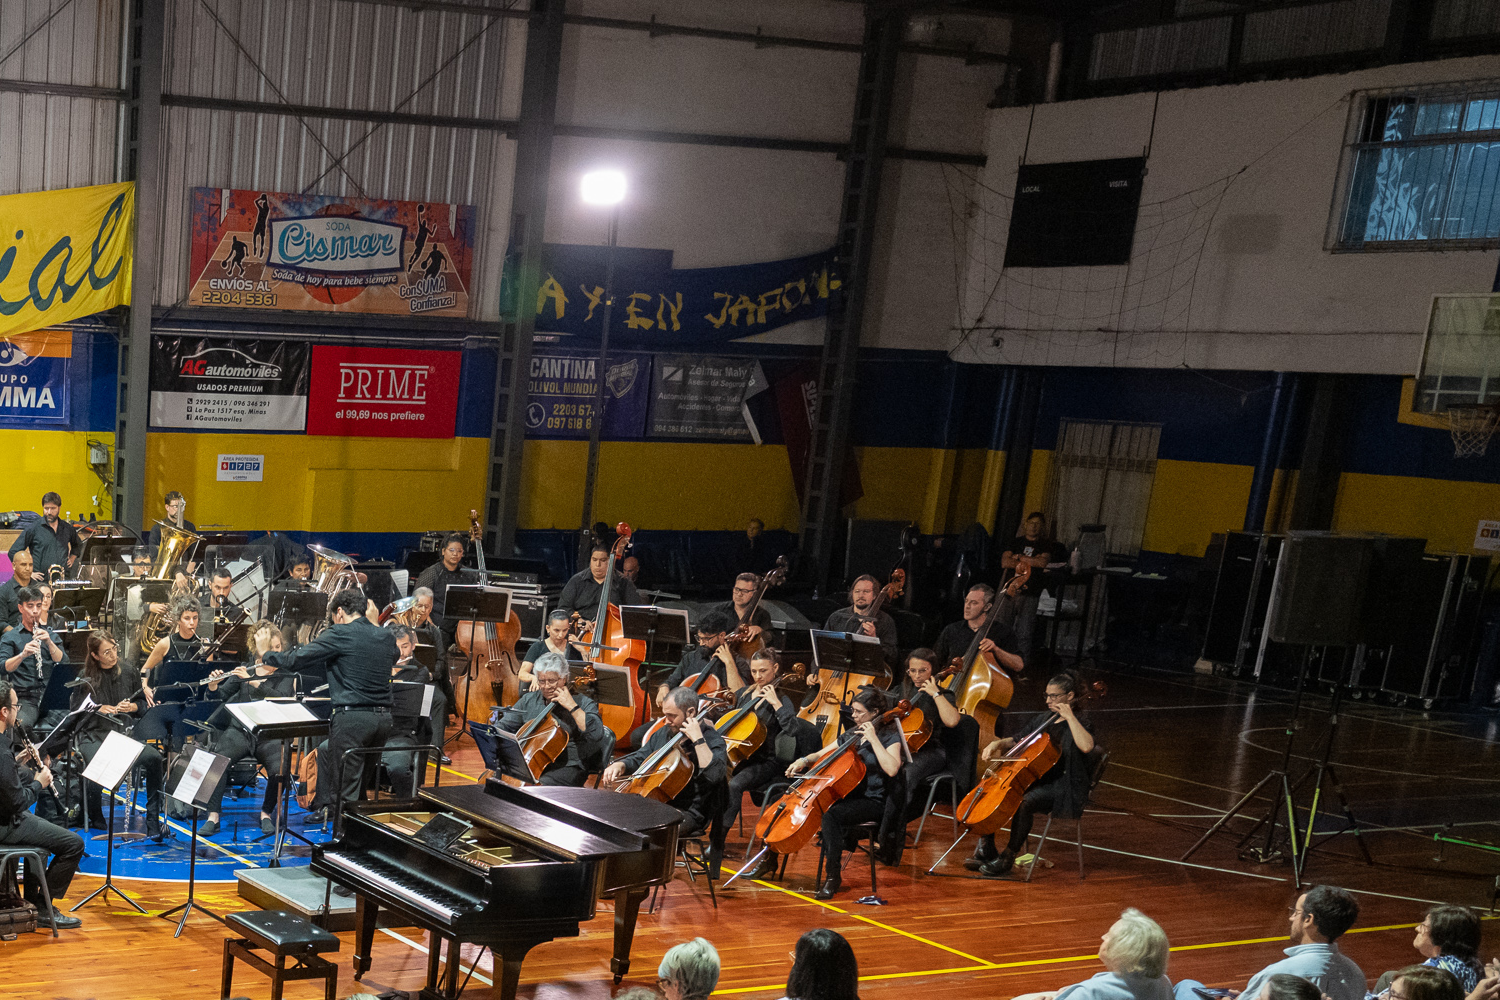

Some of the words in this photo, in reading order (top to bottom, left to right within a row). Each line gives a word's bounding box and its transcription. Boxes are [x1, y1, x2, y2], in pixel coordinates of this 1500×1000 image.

[326, 221, 351, 231] SODA
[278, 222, 396, 263] Cismar
[209, 275, 253, 291] ENVÍOS
[256, 280, 271, 292] AL
[272, 269, 293, 281] Soda
[295, 273, 305, 283] de
[306, 273, 321, 286] hoy
[323, 275, 343, 287] para
[364, 273, 397, 286] siempre
[202, 291, 241, 304] 2204
[245, 292, 277, 306] 5361
[410, 294, 456, 312] Confianza!
[623, 291, 684, 332] EN
[530, 358, 596, 380] CANTINA
[725, 367, 747, 380] Maly
[197, 383, 227, 392] USADOS
[228, 384, 263, 393] PREMIUM
[338, 368, 428, 400] PRIME
[528, 381, 560, 393] OLIVOL
[563, 382, 598, 395] MUNDIA
[336, 409, 344, 418] el
[346, 410, 370, 420] 99,69
[372, 412, 389, 420] nos
[390, 411, 425, 421] prefiere
[553, 404, 576, 416] 2203
[547, 417, 566, 429] 097
